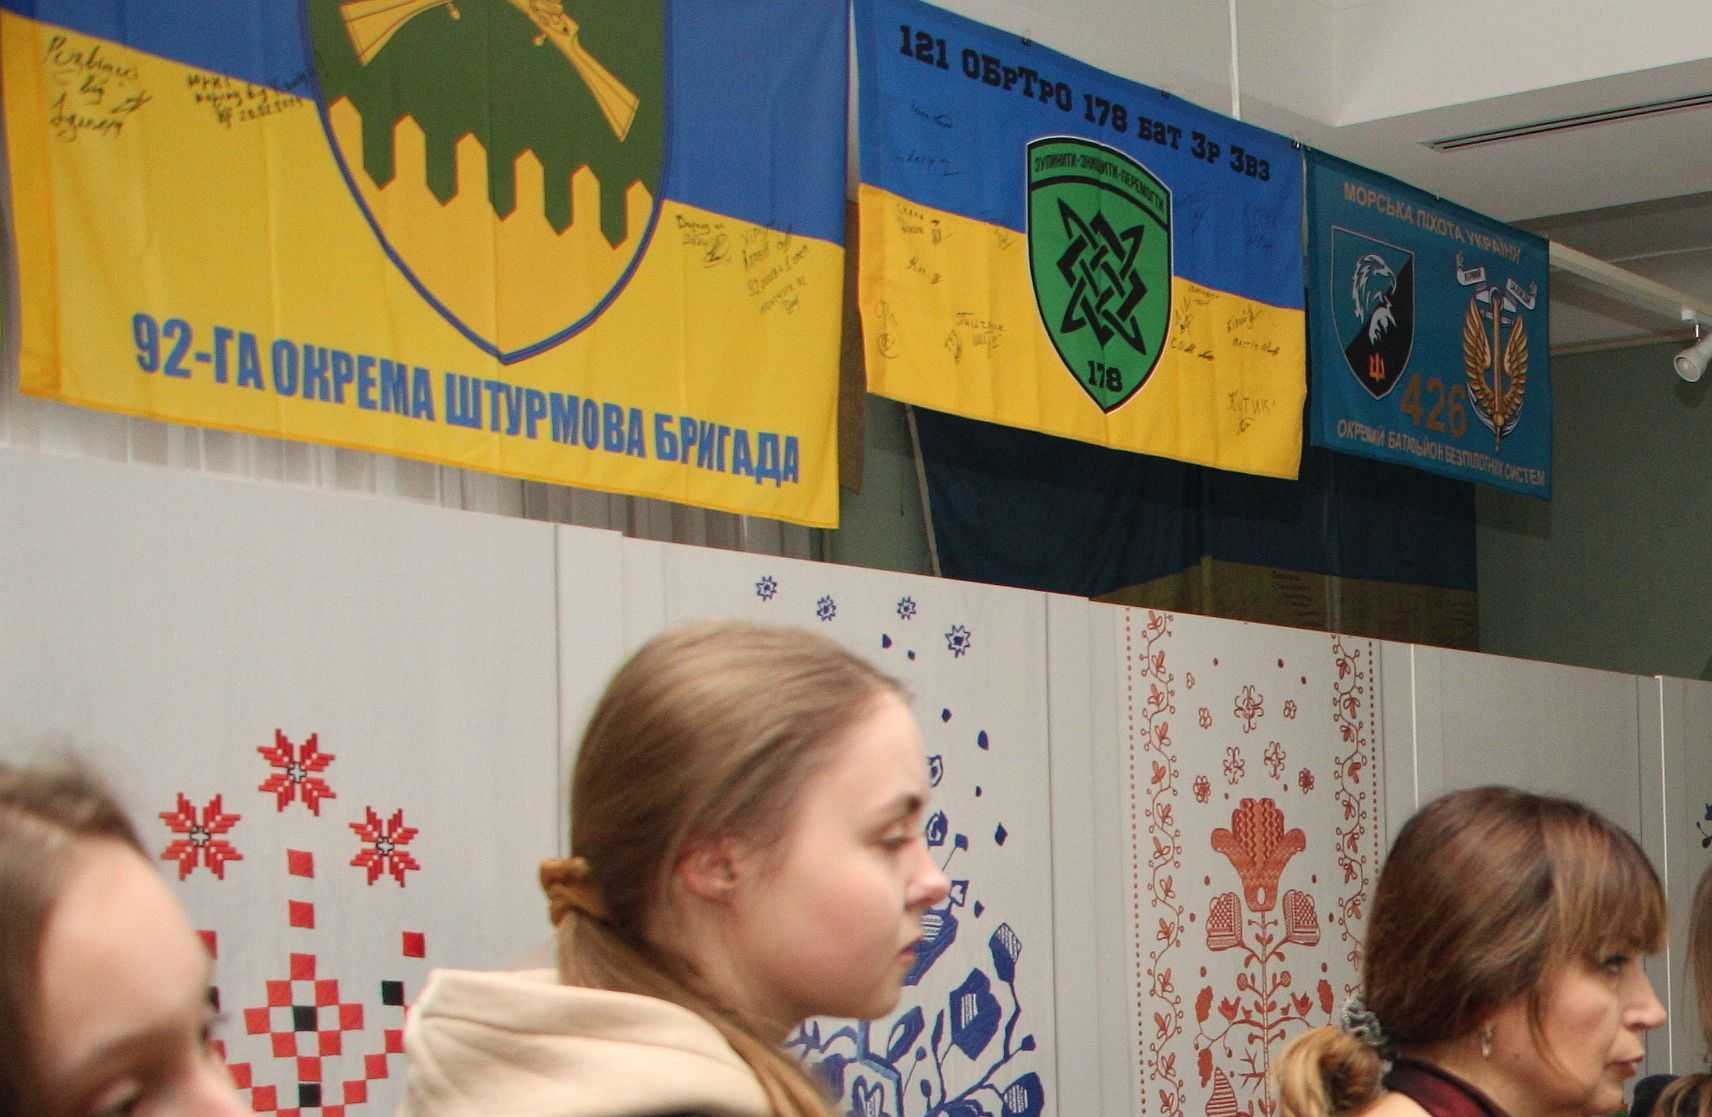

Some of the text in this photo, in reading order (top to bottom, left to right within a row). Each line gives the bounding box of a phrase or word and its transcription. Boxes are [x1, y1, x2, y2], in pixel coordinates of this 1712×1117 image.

[899, 24, 949, 70] 121
[1083, 94, 1128, 133] 178
[1343, 181, 1414, 224] МОРСЬКА
[1416, 208, 1464, 242] ПІХОТА
[132, 312, 800, 488] 92-ГА ОКРЕМА ШТУРМОВА БРИГАДА
[1088, 360, 1123, 393] 178
[1401, 371, 1469, 439] 426
[1336, 418, 1385, 448] ОКРЕМИЙ
